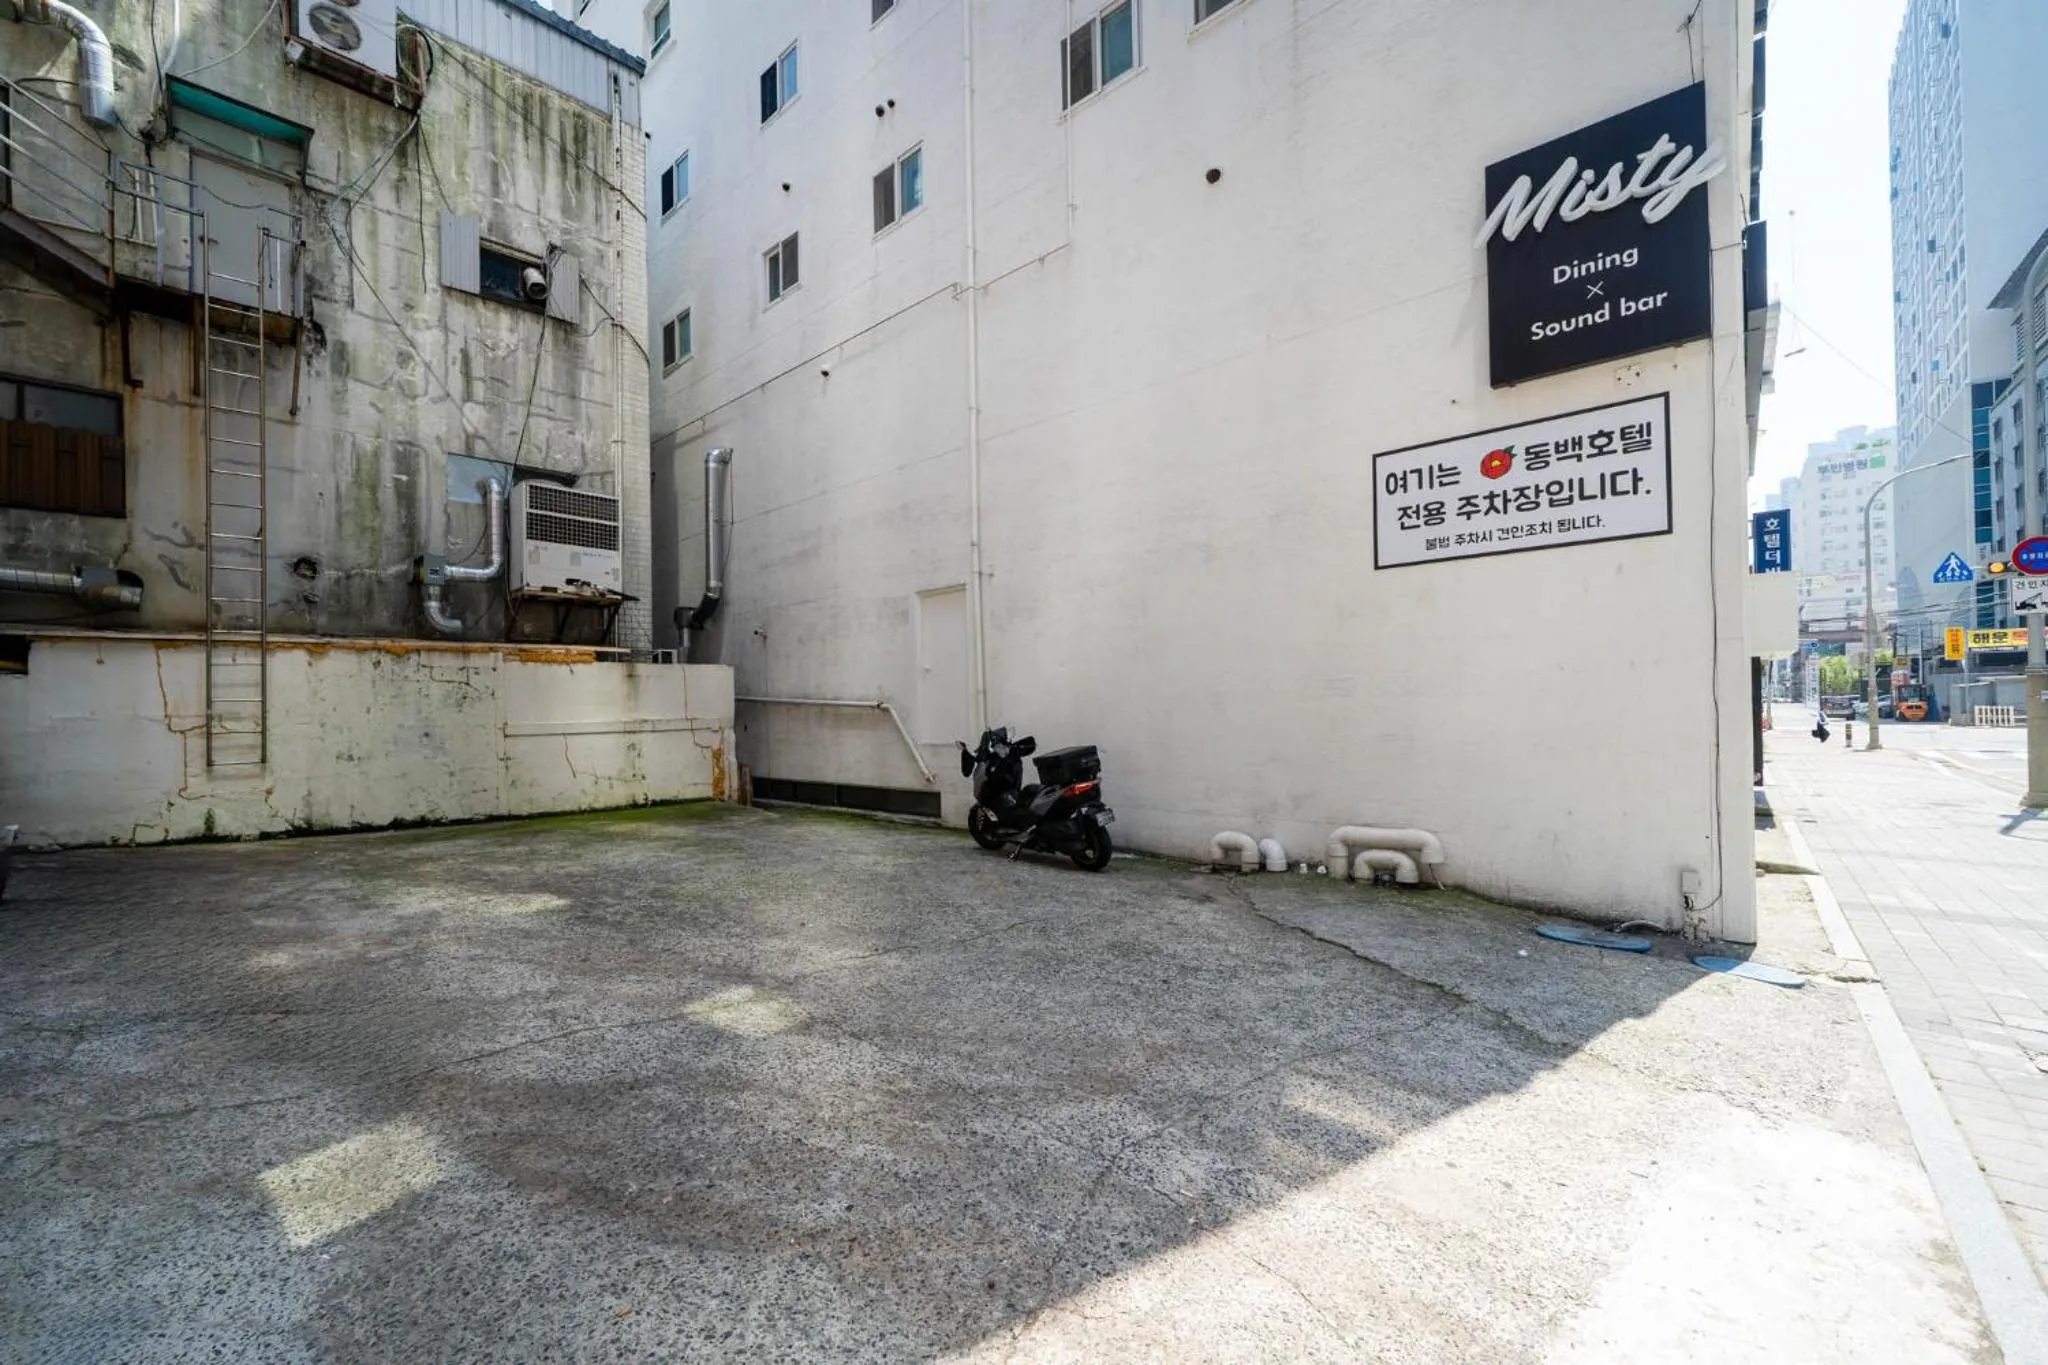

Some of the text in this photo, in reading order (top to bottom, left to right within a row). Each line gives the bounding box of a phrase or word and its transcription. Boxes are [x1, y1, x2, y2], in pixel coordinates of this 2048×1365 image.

[1474, 133, 1726, 249] Misty
[1553, 248, 1639, 284] Dining
[1531, 290, 1669, 341] Sound bar
[1384, 421, 1653, 495] 여기는 동백호텔
[1397, 467, 1652, 530] 전용 주차장입니다.
[1424, 514, 1606, 551] 불법 주차시 견인조치 됩니다.
